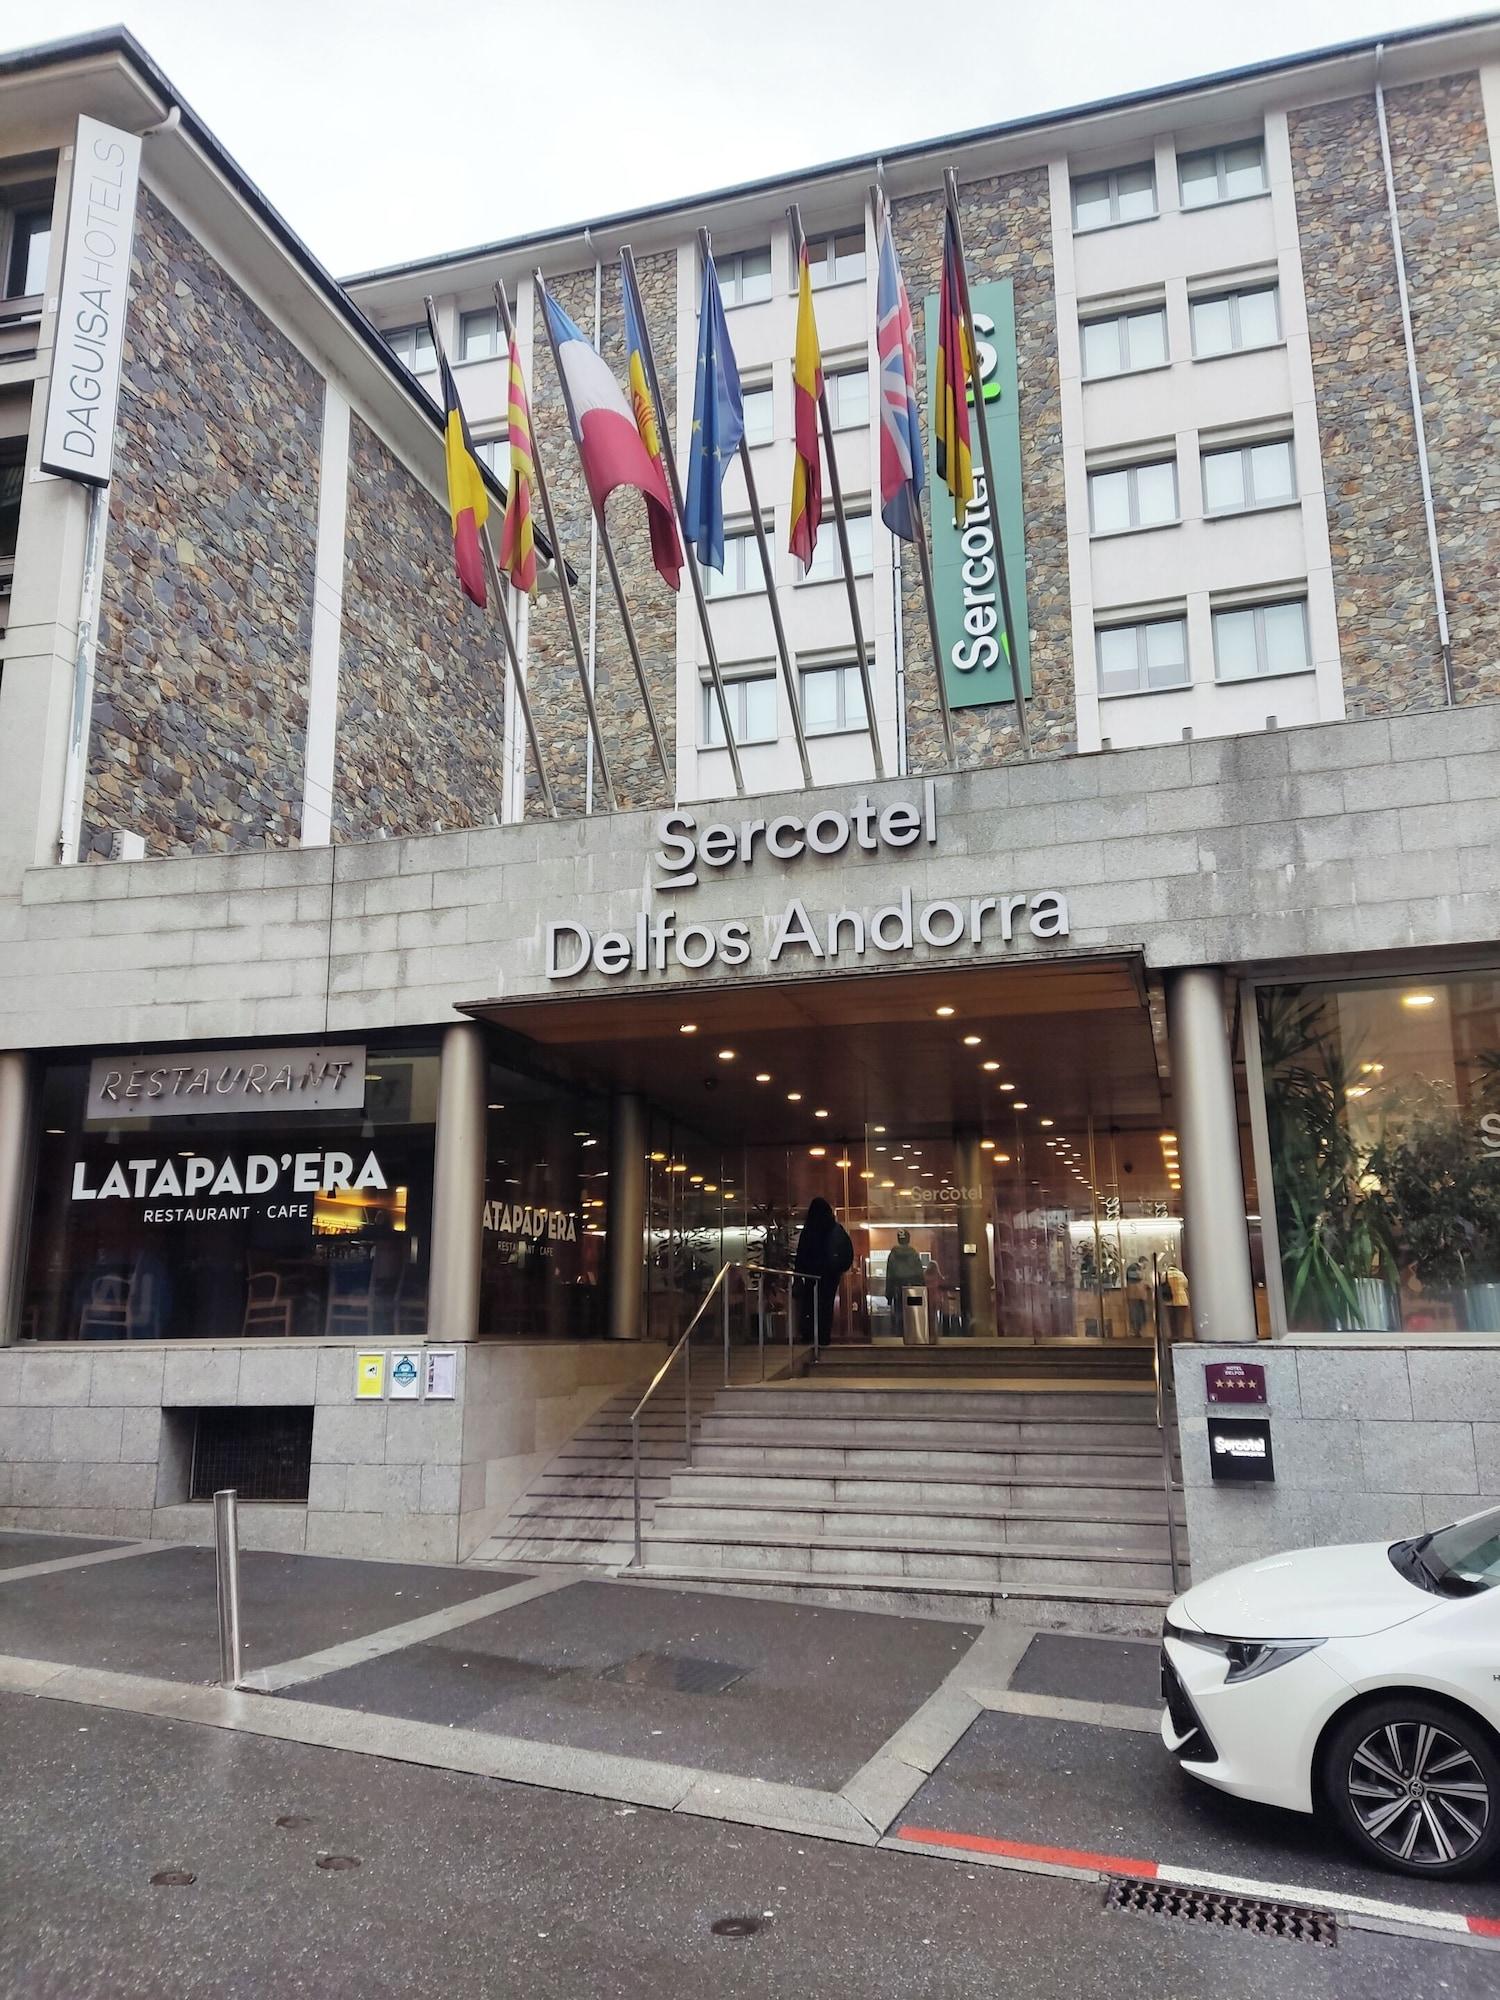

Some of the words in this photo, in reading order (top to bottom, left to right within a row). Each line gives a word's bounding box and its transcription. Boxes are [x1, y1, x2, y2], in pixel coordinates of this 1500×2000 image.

[654, 780, 938, 872] Sercotel
[545, 908, 751, 979] Delfos
[769, 885, 1070, 960] Andorra
[99, 1060, 352, 1101] RESTAURANT
[72, 1150, 389, 1200] LATAPAD'ERA
[911, 1183, 983, 1201] Sercotel
[143, 1206, 250, 1223] RESTAURANT
[266, 1205, 308, 1219] CAFE
[483, 1200, 577, 1242] ATAPAD'ERA
